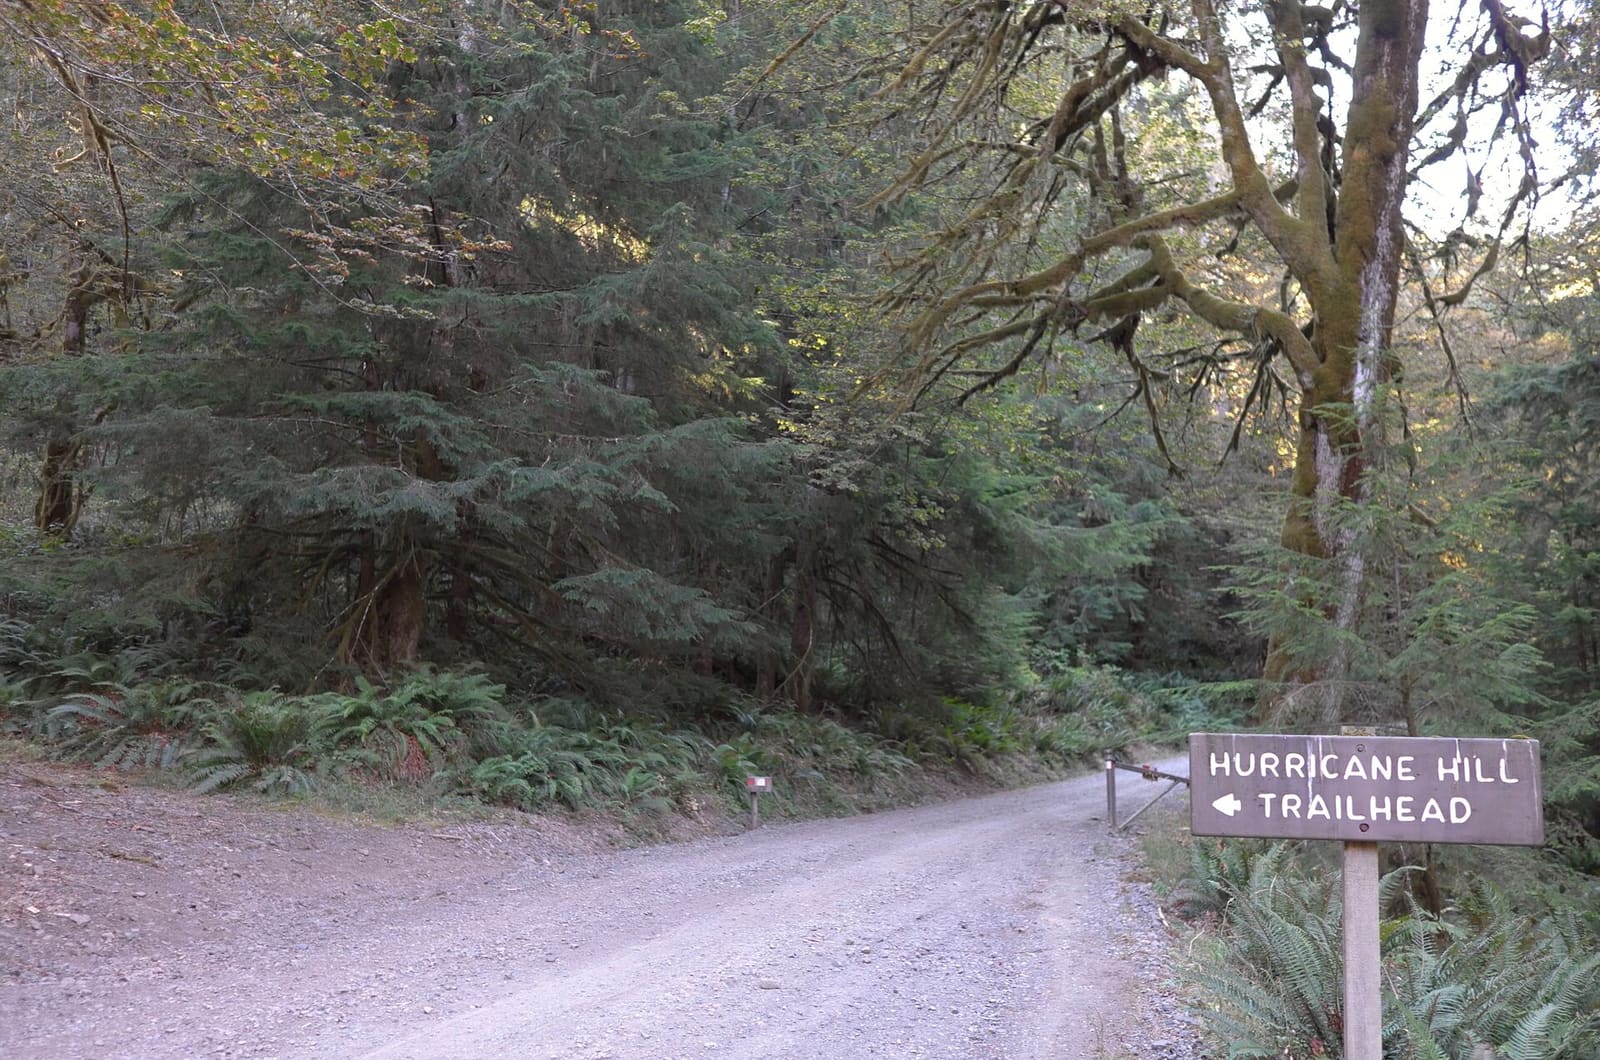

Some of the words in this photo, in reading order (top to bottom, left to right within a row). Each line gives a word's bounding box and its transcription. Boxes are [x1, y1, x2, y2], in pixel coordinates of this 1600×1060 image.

[1209, 751, 1416, 782] HURRICANE
[1437, 756, 1520, 784] HILL
[1258, 792, 1472, 825] TRAILHEAD
